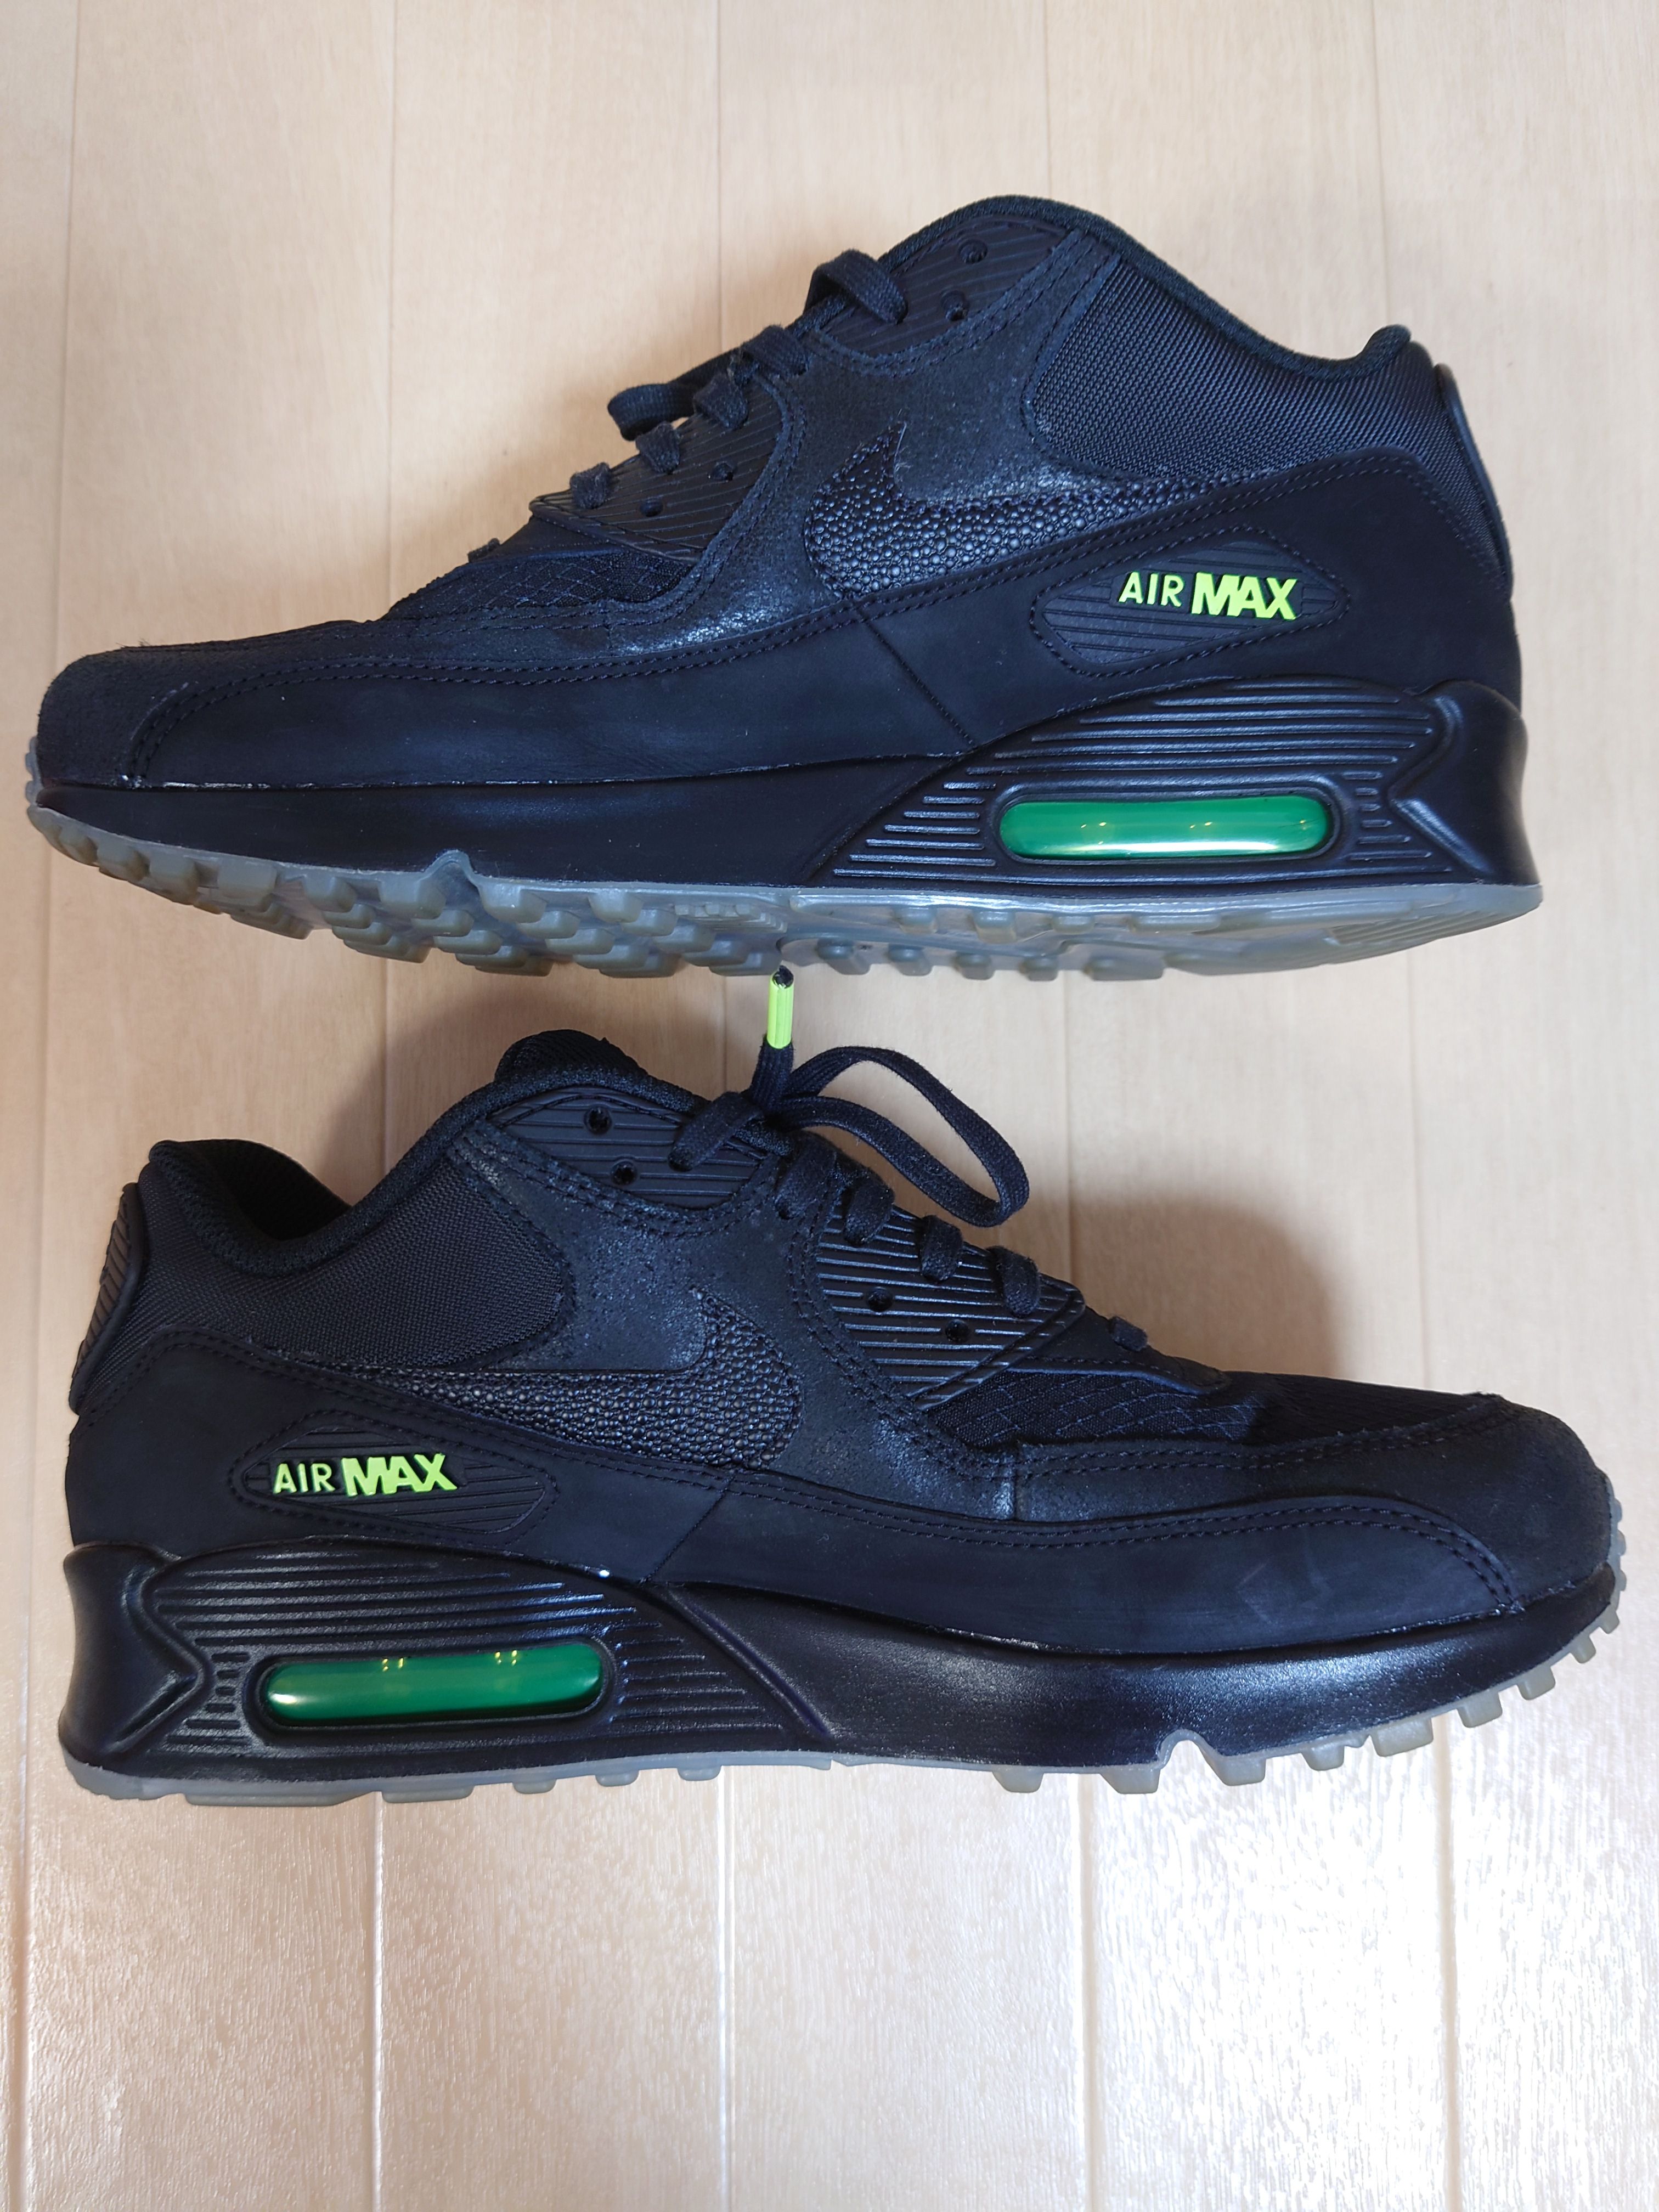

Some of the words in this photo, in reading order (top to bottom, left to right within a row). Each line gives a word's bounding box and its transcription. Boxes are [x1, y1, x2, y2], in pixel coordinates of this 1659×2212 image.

[1118, 572, 1185, 607] AIR
[1191, 572, 1298, 620] MAX
[273, 1463, 336, 1494] AIR
[341, 1453, 458, 1497] MAX
